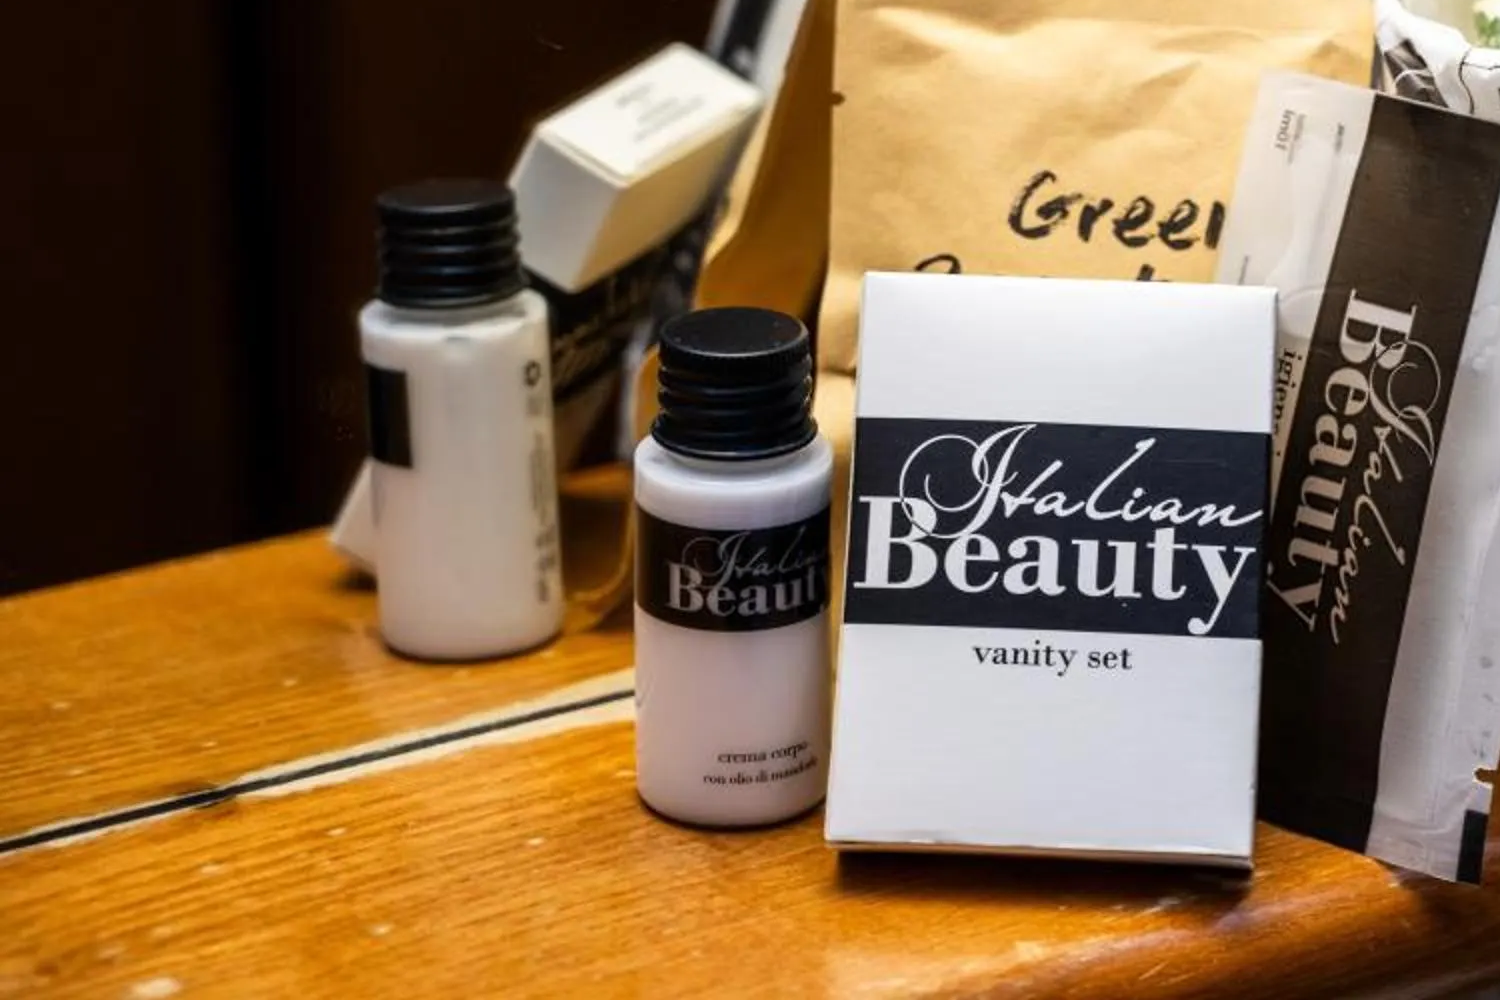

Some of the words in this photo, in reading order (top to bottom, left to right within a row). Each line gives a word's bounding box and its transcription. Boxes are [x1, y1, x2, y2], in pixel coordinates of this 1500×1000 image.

[1275, 348, 1304, 437] igien
[899, 423, 1264, 538] Italian
[1266, 289, 1416, 633] Beauty
[1330, 339, 1441, 645] Italian
[663, 558, 826, 618] Beaut
[681, 524, 824, 590] Itali
[853, 495, 1256, 637] Beauty
[973, 642, 1078, 678] vanity
[1087, 646, 1133, 671] set
[703, 774, 726, 785] con
[717, 752, 768, 764] crema
